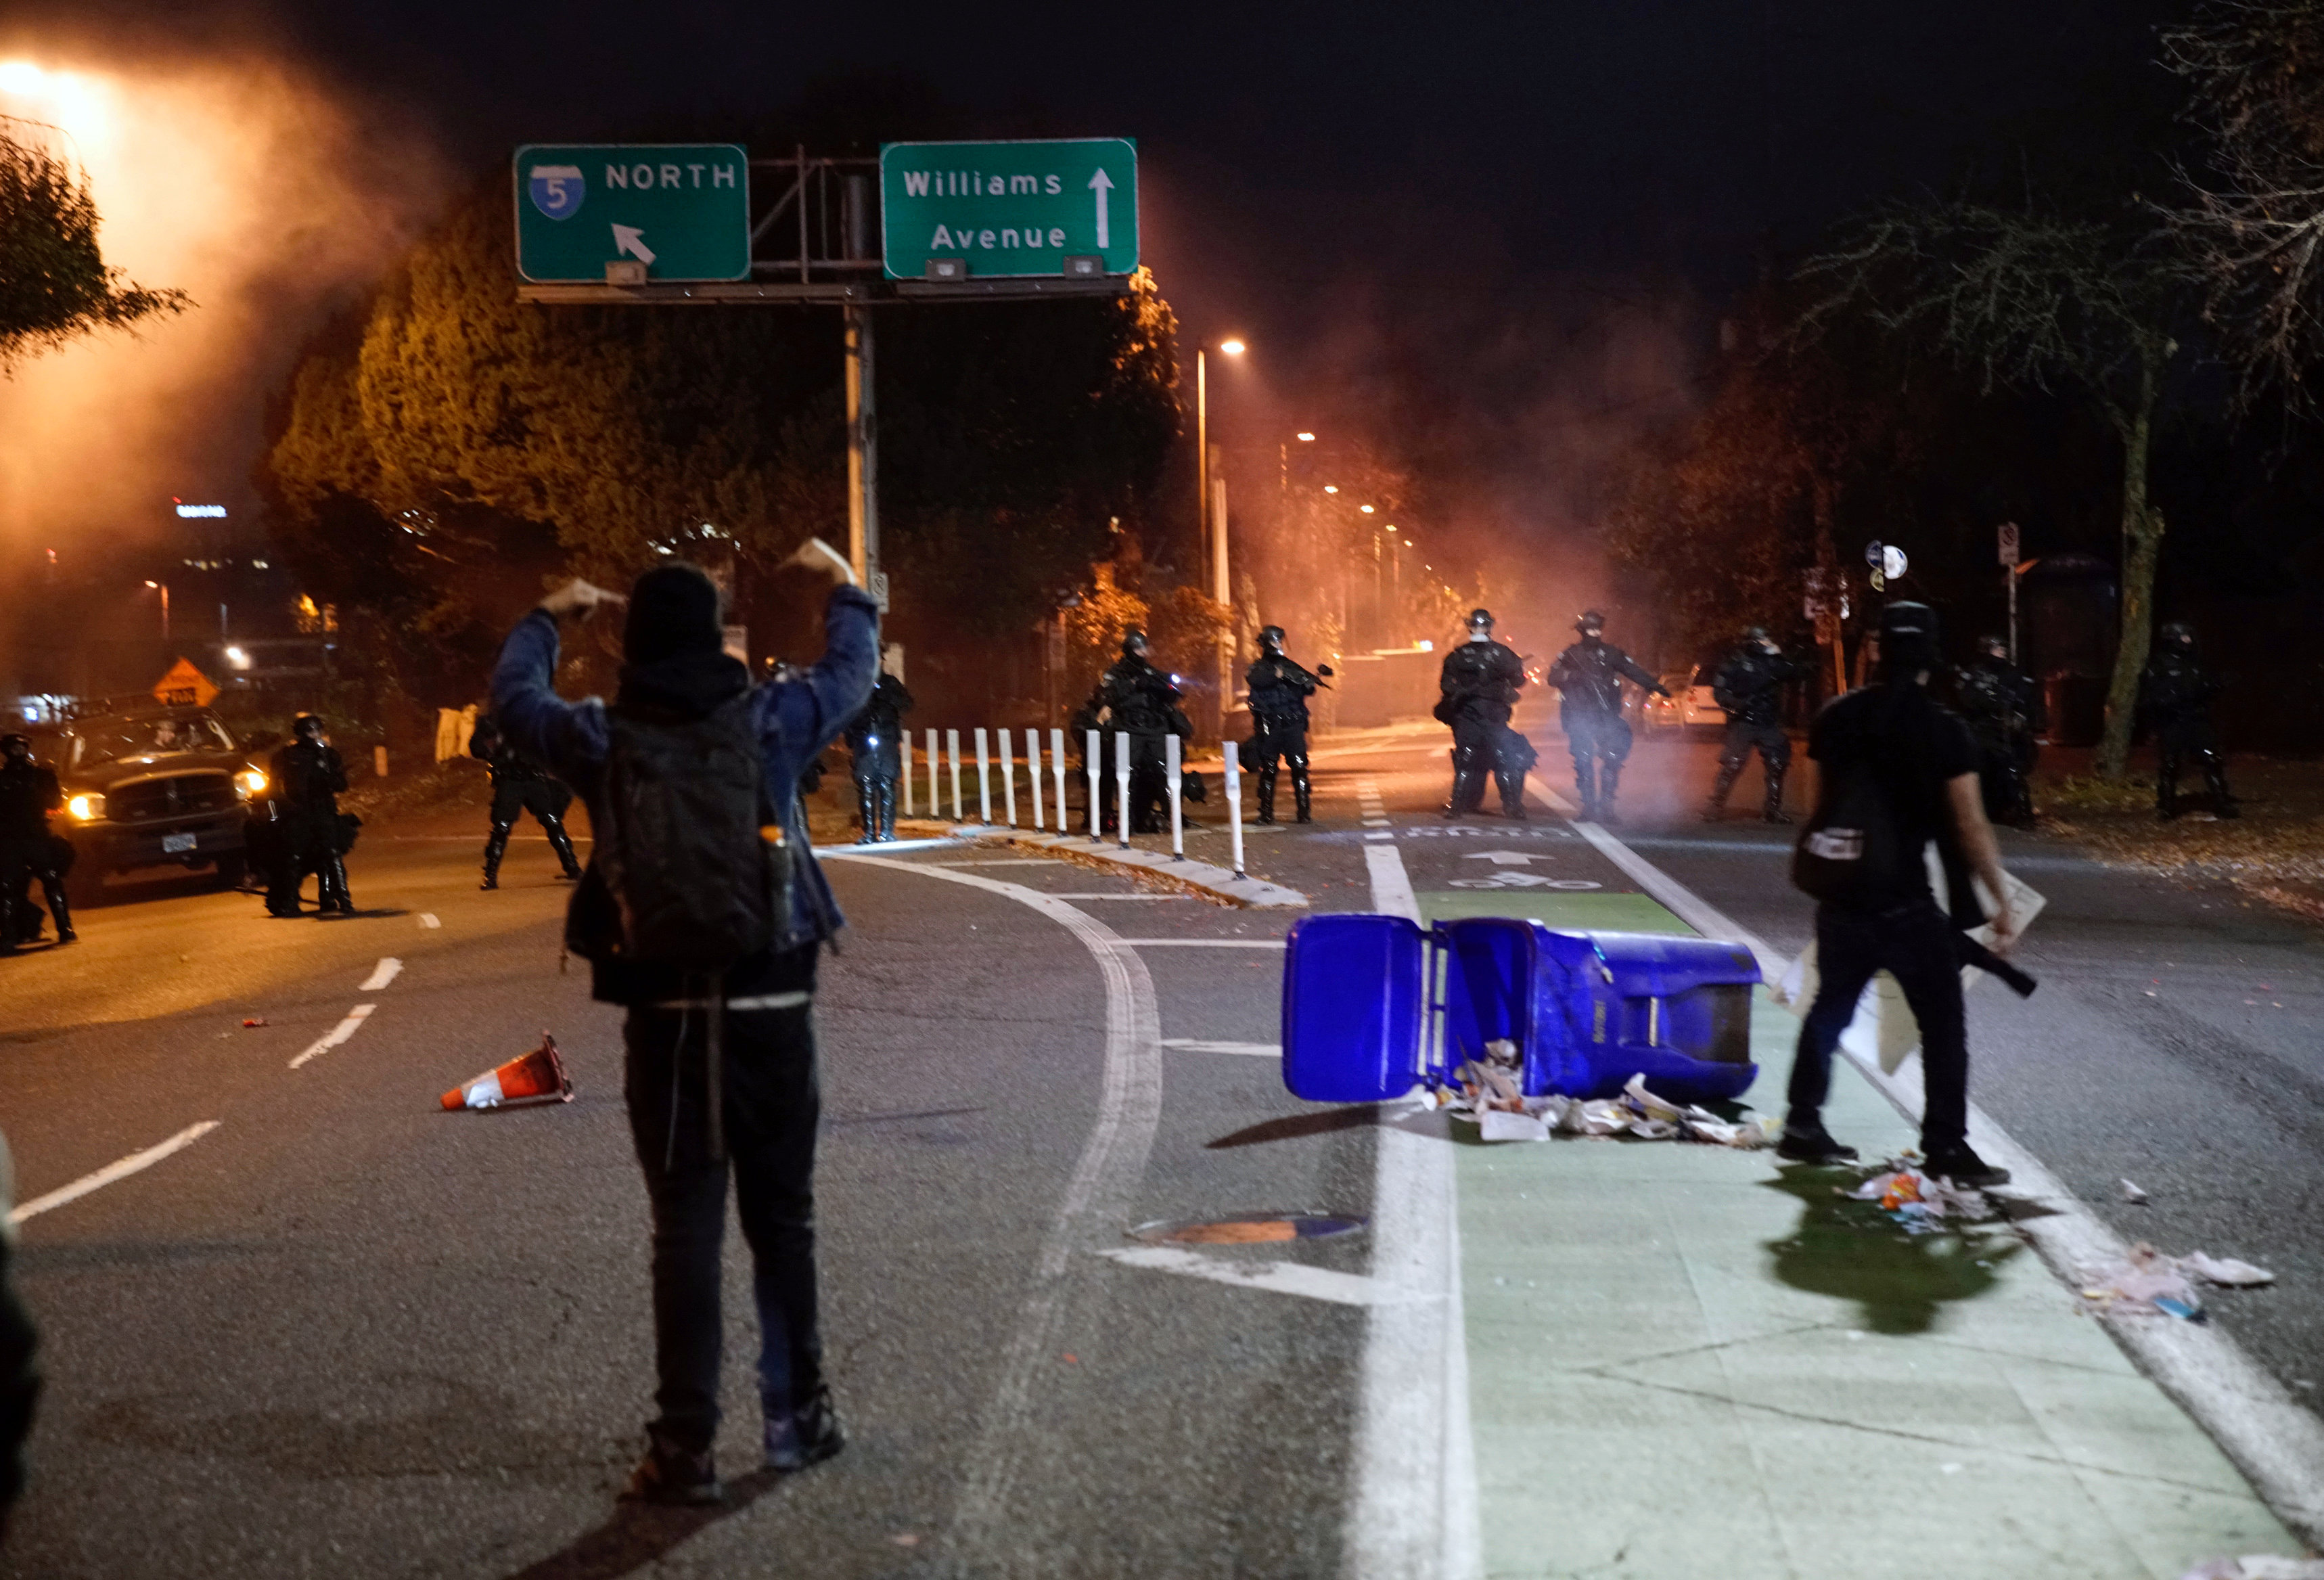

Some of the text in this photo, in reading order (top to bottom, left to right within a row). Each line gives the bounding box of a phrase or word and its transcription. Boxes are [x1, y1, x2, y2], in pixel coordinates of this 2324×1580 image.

[606, 164, 736, 189] NORTH
[903, 171, 1062, 197] Williams
[547, 178, 568, 209] 5
[931, 224, 1066, 250] Avenue
